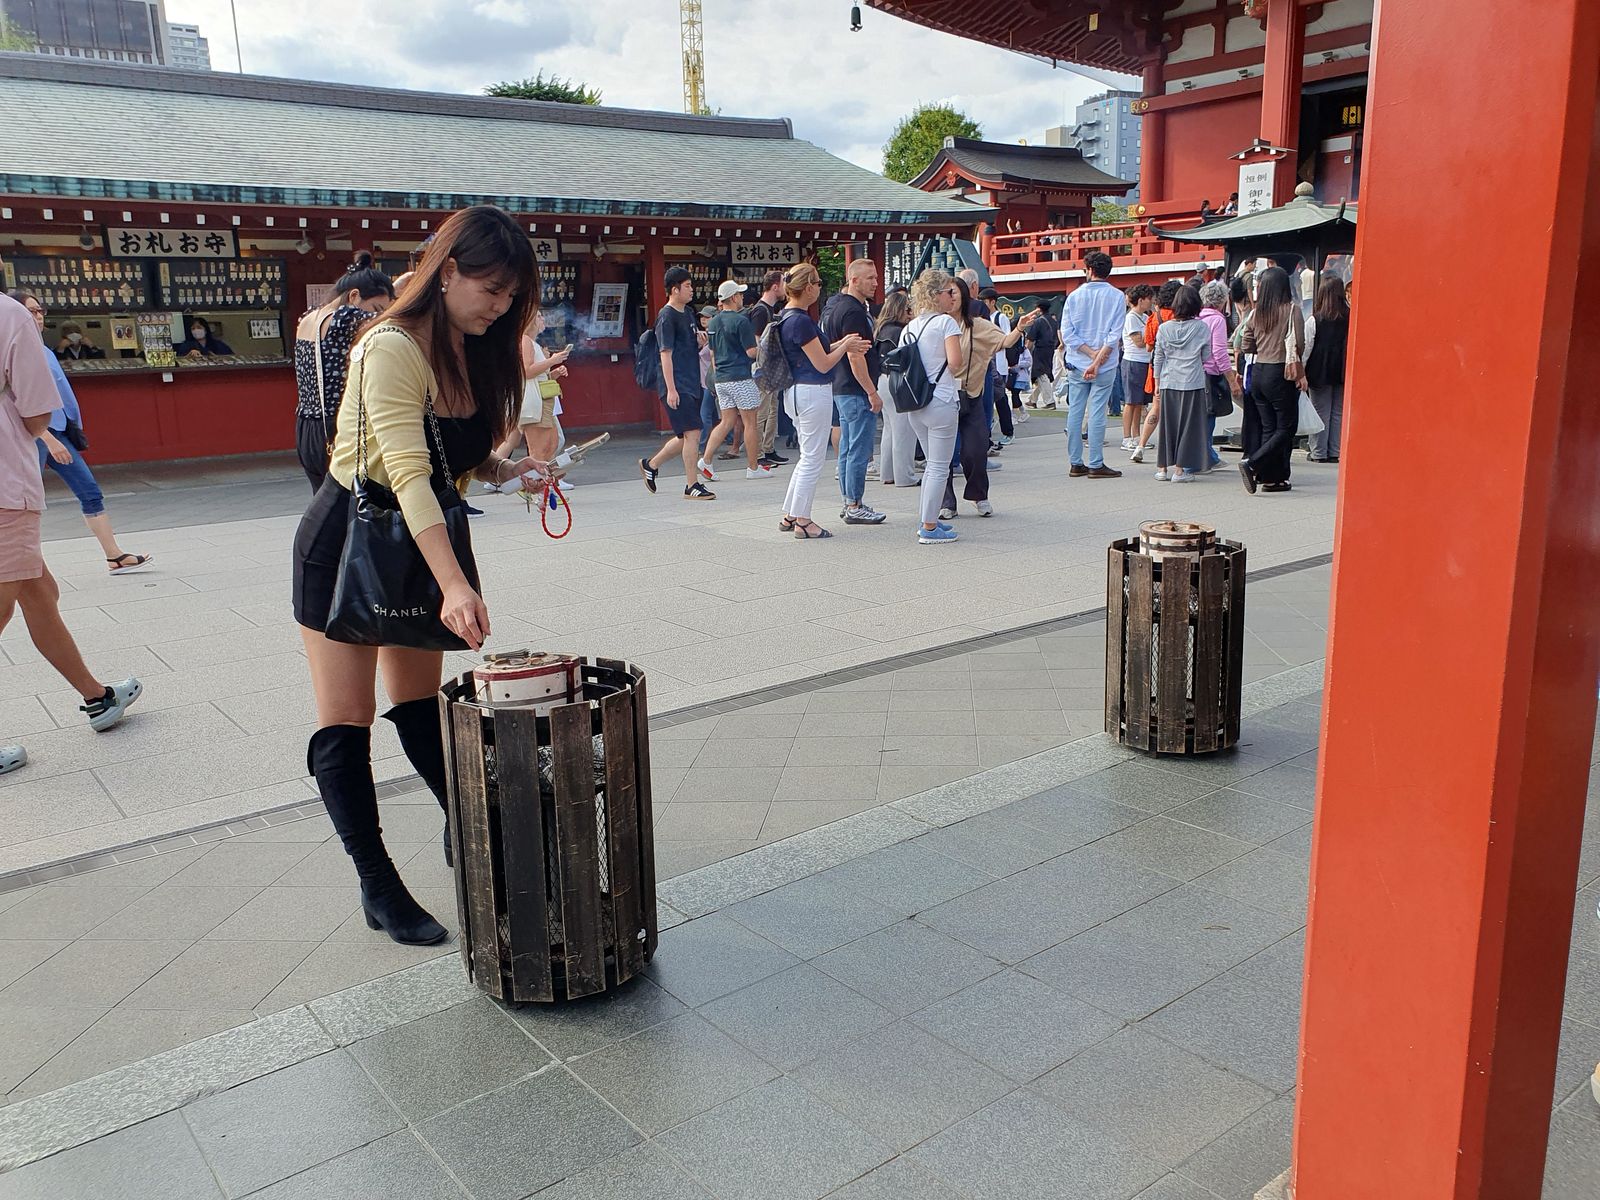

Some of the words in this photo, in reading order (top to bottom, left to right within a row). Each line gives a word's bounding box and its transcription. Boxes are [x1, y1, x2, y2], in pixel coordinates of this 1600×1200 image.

[118, 230, 226, 255] お札お守
[736, 244, 795, 262] お札お守
[374, 604, 427, 617] CHANEL
